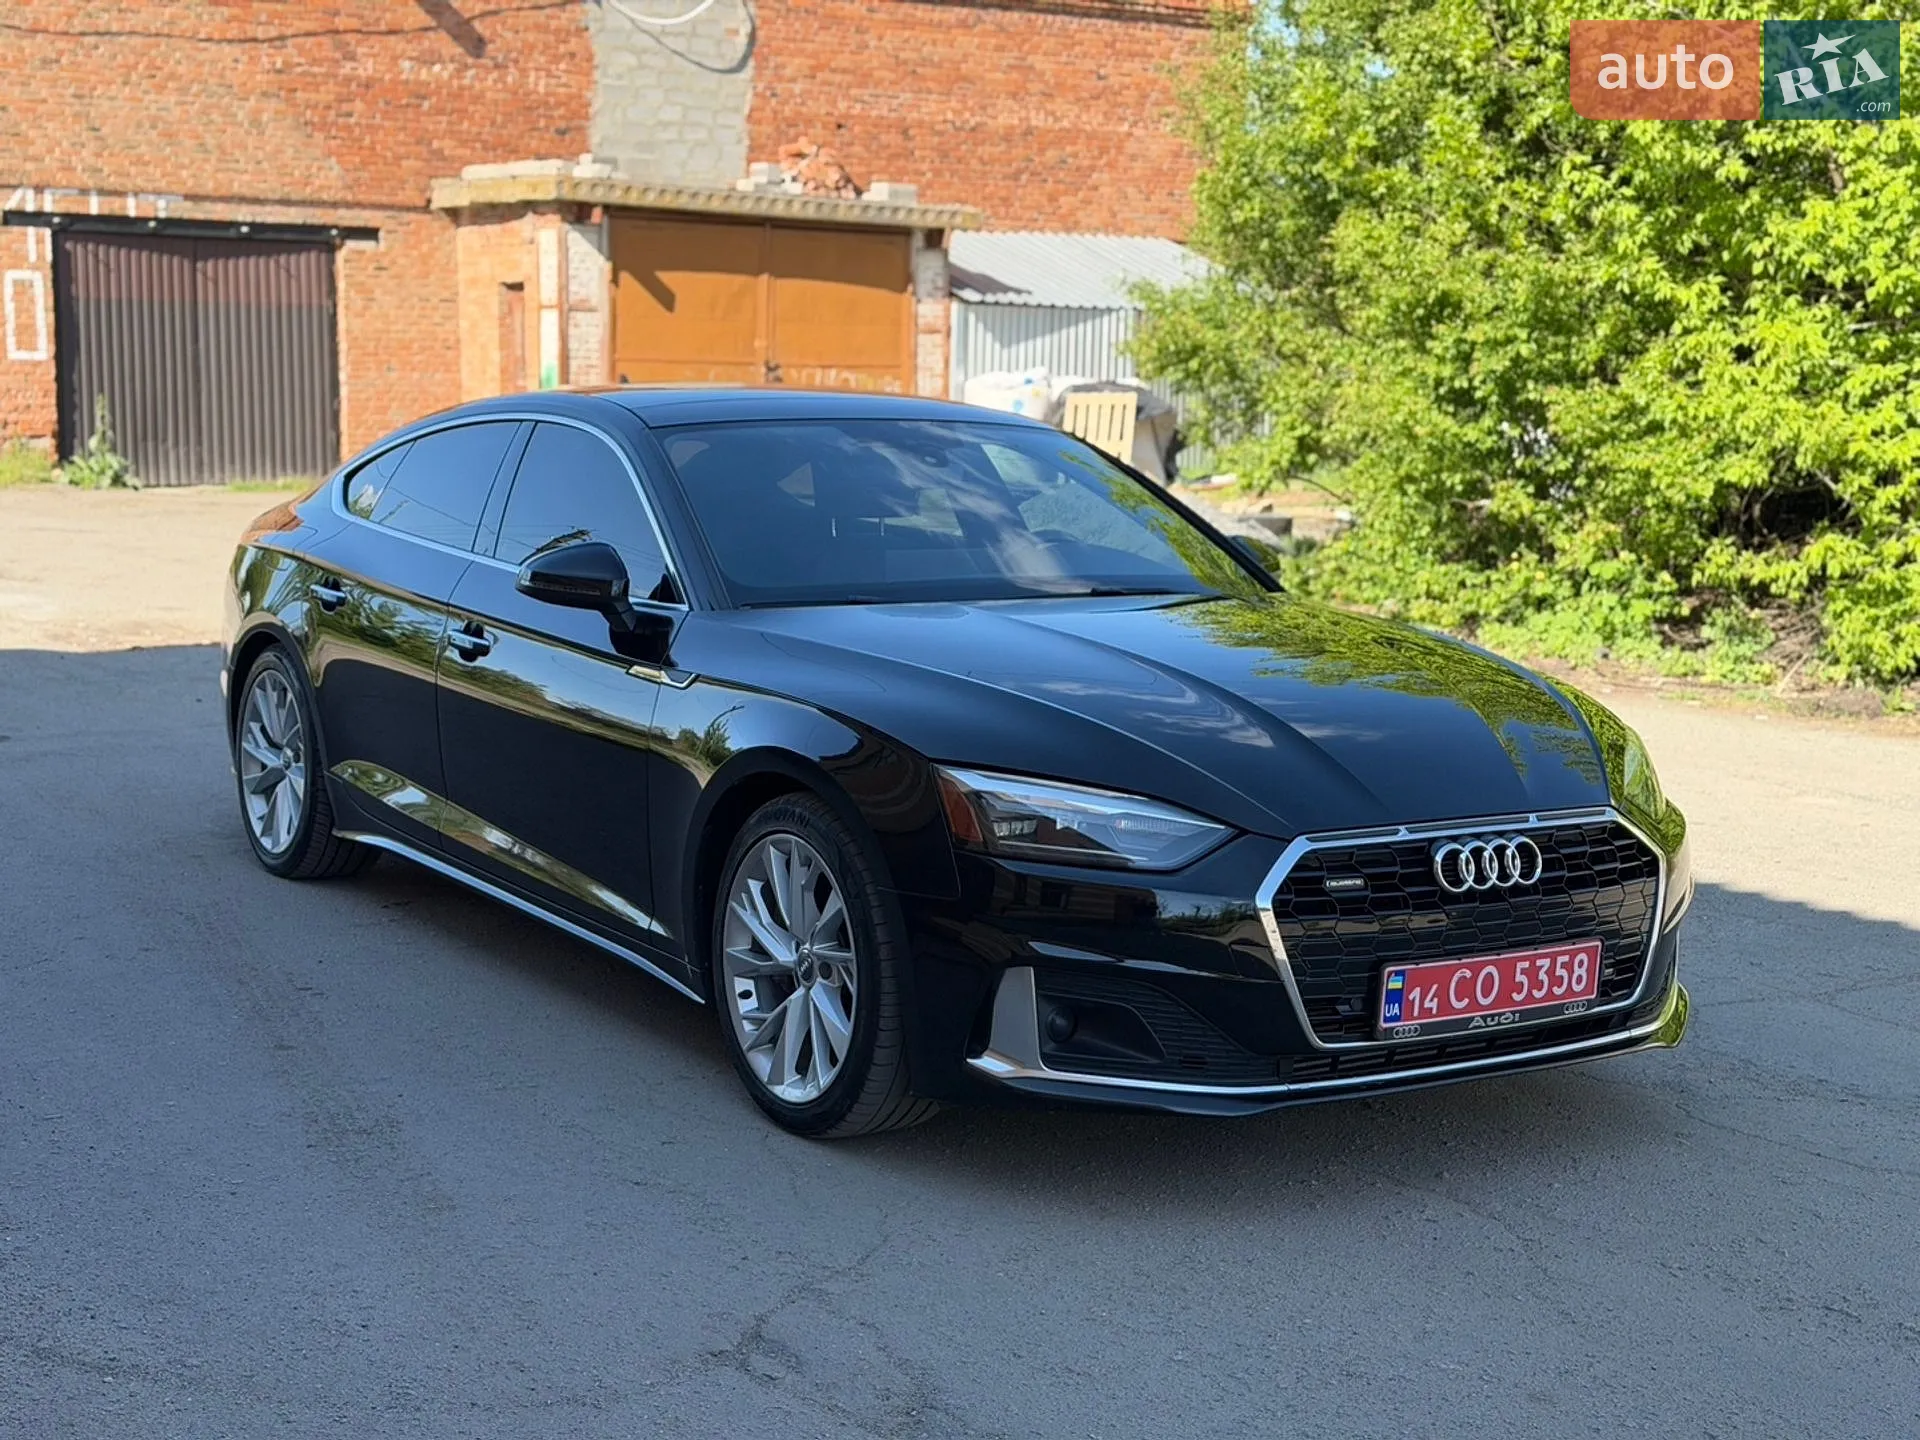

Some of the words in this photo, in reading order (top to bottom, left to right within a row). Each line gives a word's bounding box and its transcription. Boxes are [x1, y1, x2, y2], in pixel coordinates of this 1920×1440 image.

[1408, 983, 1438, 1017] 14
[1449, 965, 1499, 1009] CO
[1511, 952, 1589, 1001] 5358
[1385, 1003, 1400, 1017] UA
[1468, 1012, 1520, 1029] Audi
